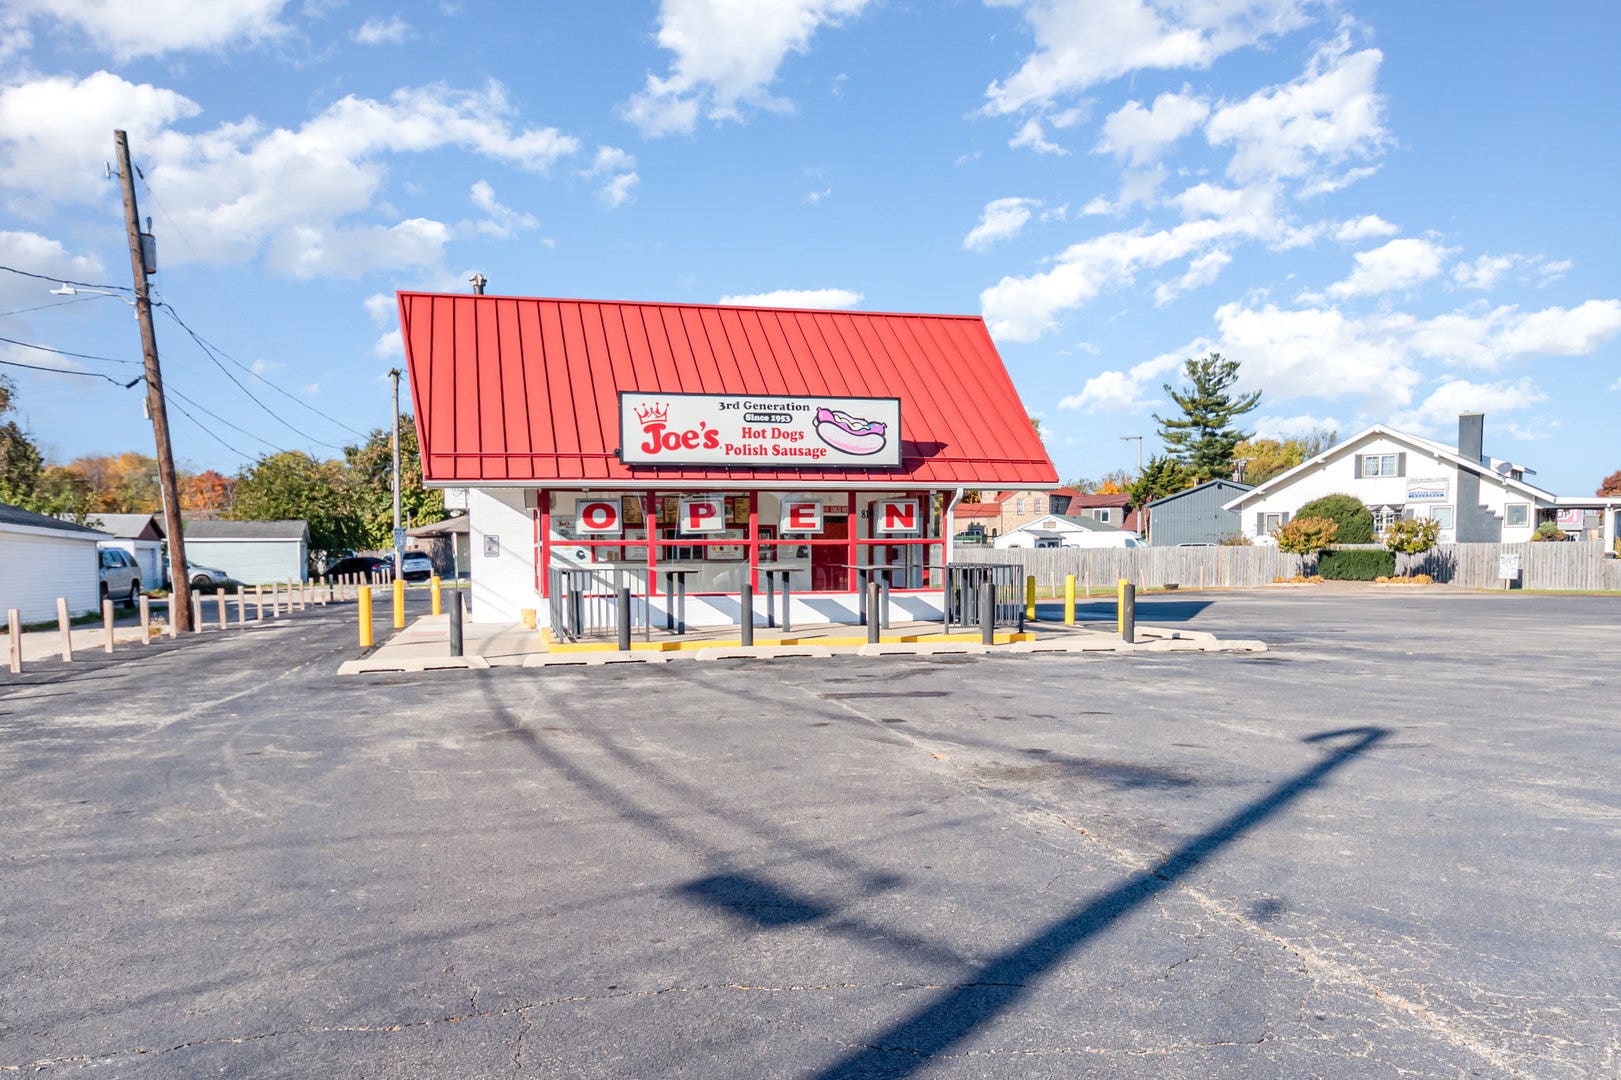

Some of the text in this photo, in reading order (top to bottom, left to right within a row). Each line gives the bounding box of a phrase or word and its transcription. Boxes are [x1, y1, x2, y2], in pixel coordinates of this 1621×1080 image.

[719, 401, 810, 412] 3rd Generation
[745, 413, 791, 423] Since 1953
[641, 421, 719, 454] Joe's
[742, 427, 804, 442] Hot Dogs
[725, 443, 827, 460] Polish Sausage
